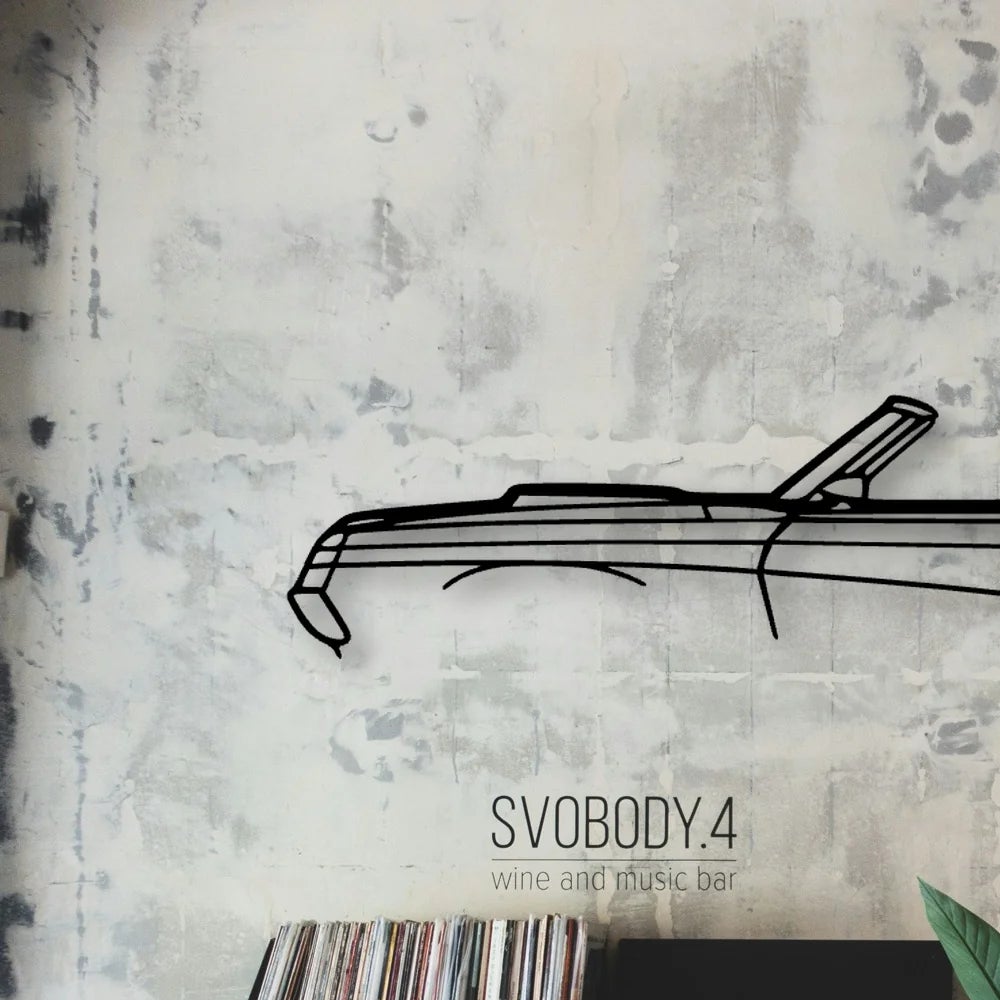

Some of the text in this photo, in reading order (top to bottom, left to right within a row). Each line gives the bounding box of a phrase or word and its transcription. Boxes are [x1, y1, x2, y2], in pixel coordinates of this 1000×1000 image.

[491, 795, 737, 849] SVOBODY.4
[491, 865, 737, 891] wine and music bar
